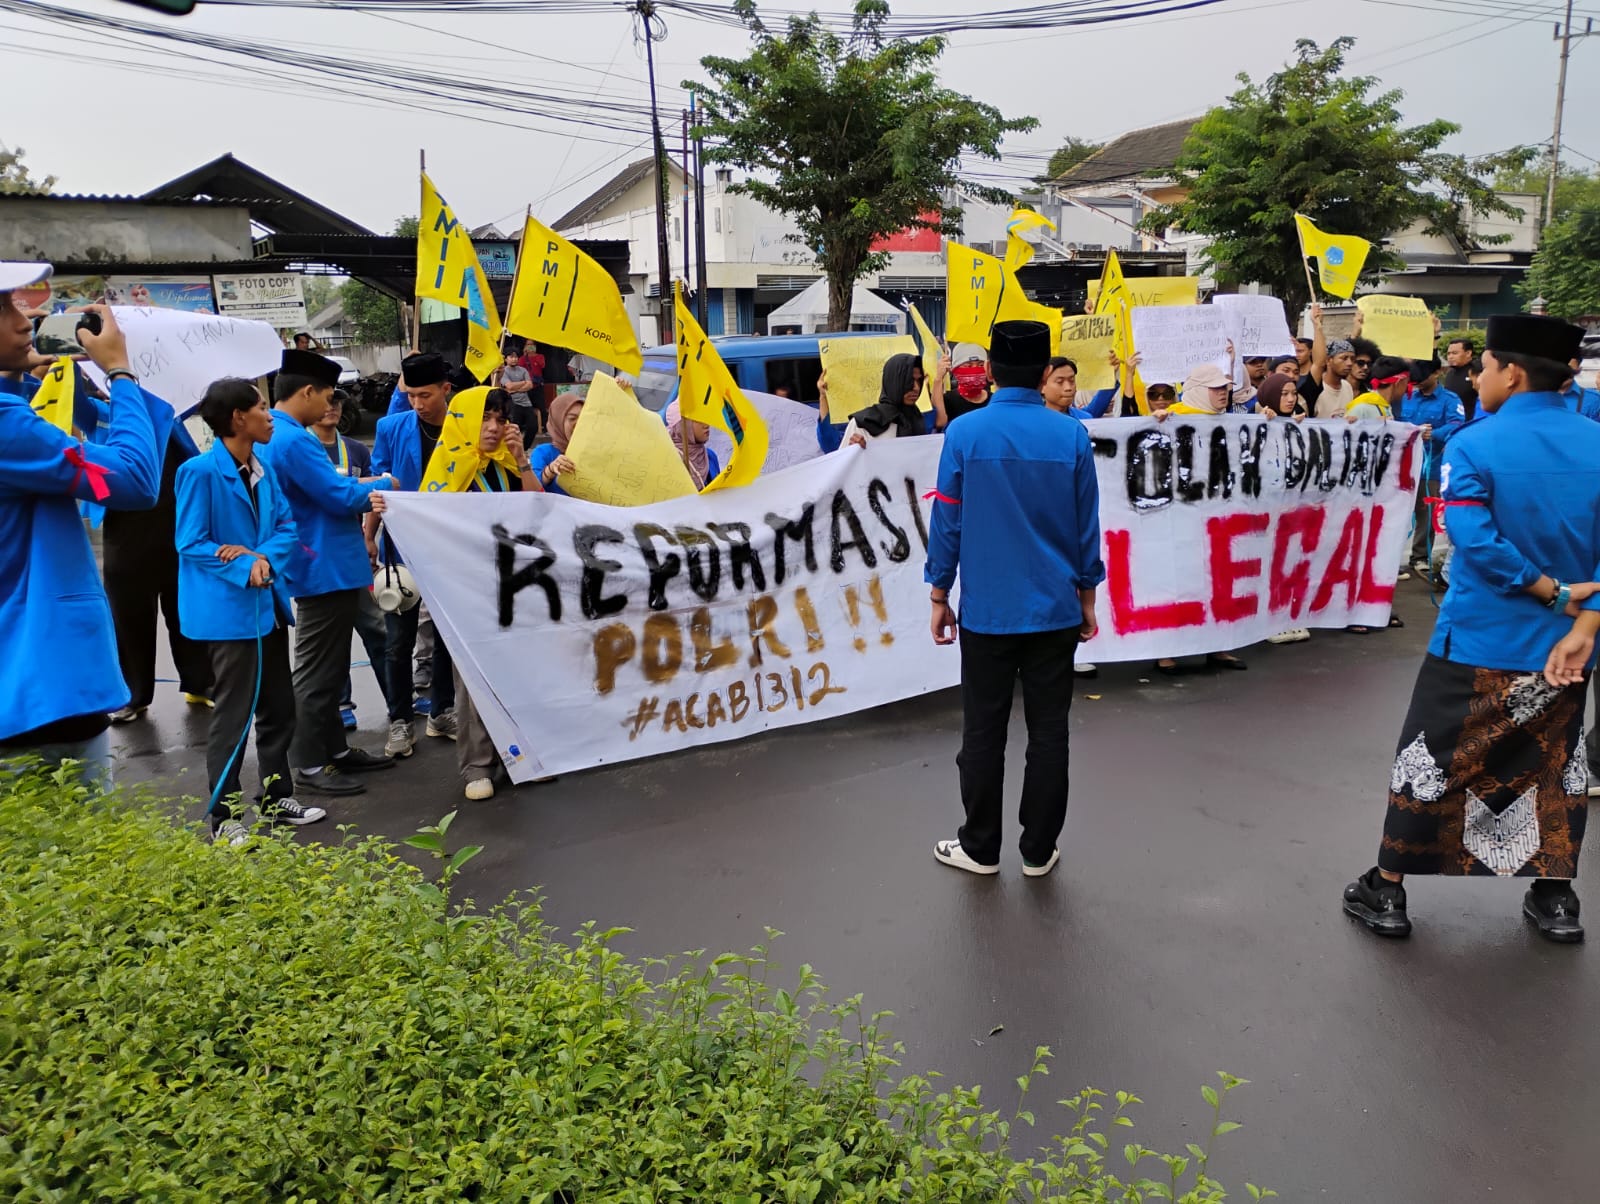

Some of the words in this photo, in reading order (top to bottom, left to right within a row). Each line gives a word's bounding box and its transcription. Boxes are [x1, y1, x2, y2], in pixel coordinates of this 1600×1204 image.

[239, 279, 266, 289] FOTO
[268, 277, 296, 288] COPY
[538, 241, 559, 317] PMII
[1104, 502, 1395, 637] LEGAL
[620, 661, 848, 742] #ACAB1312
